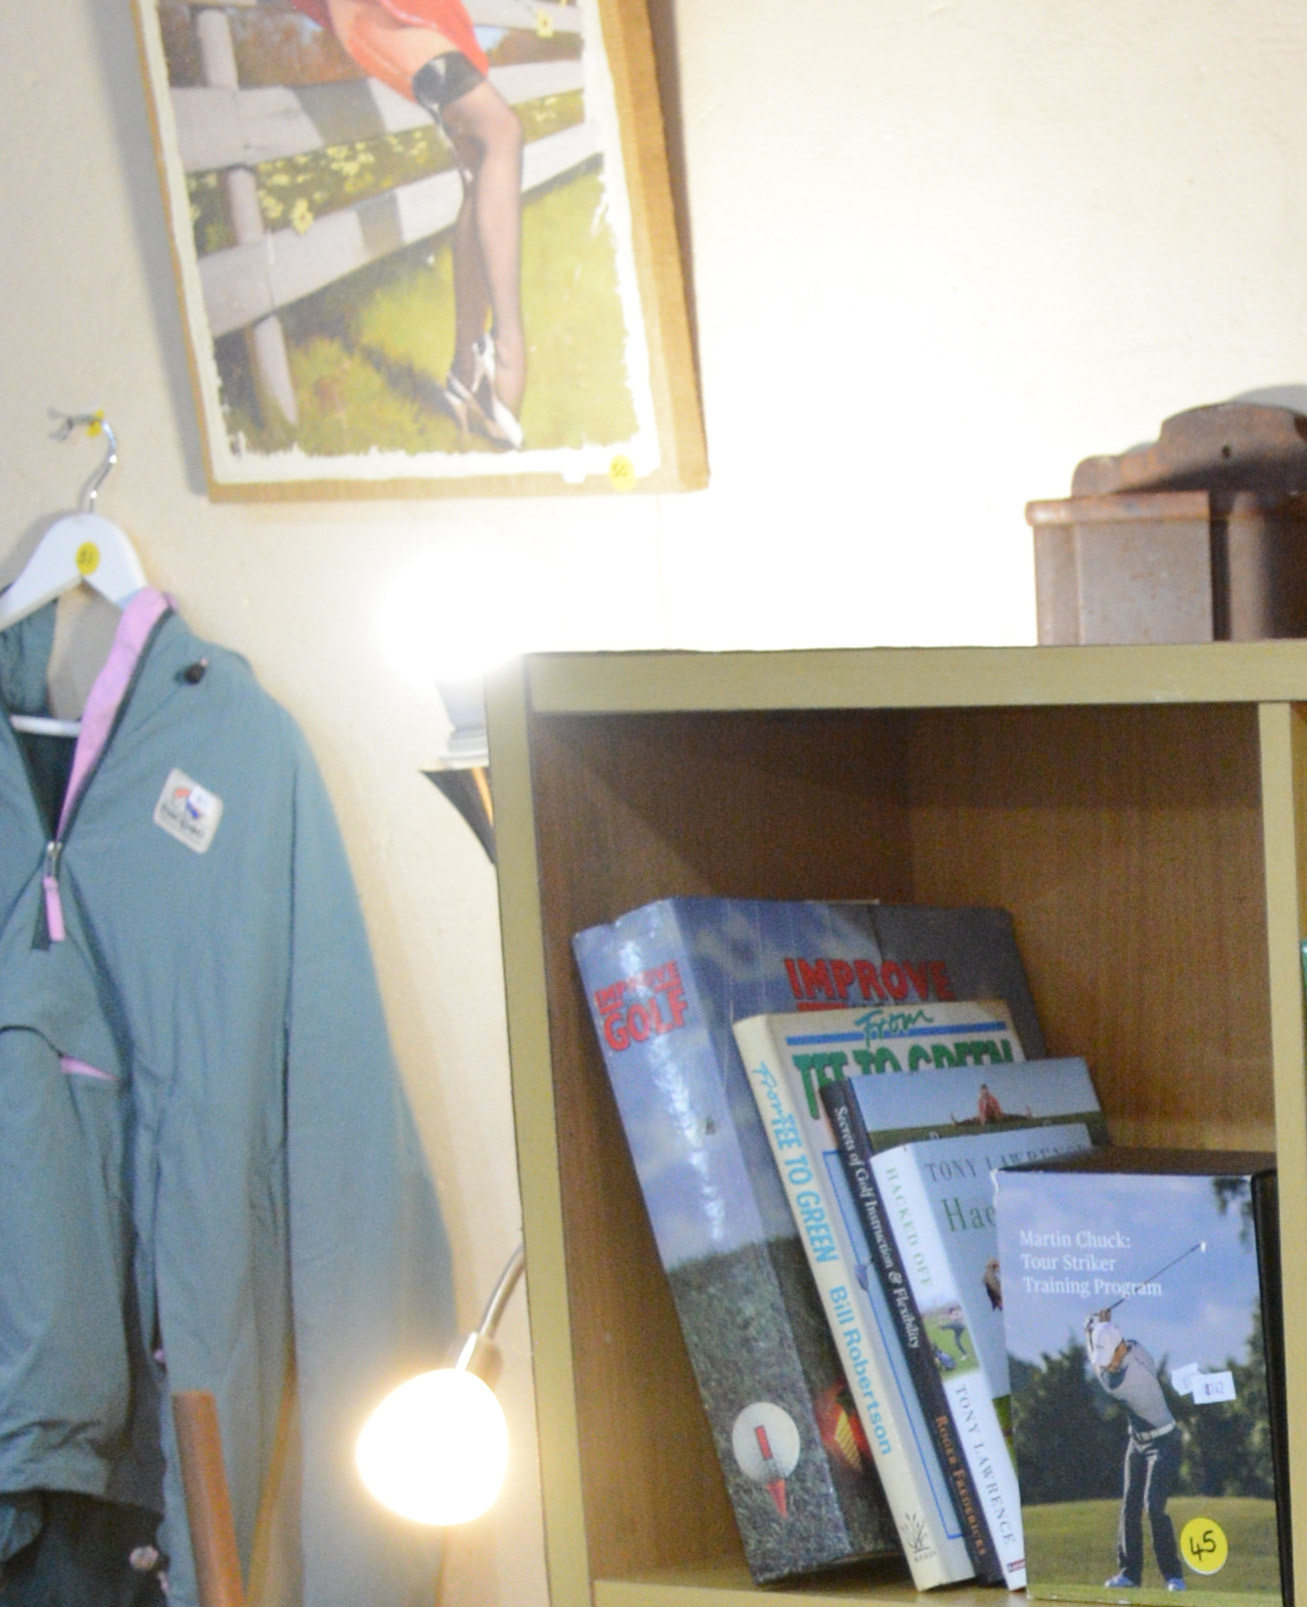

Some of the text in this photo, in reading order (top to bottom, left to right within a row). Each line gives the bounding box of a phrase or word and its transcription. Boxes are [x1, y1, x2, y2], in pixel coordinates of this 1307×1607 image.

[595, 960, 679, 1006] IMPROVE
[784, 957, 955, 1000] IMPROVE
[602, 987, 689, 1051] GOLF
[855, 1008, 933, 1048] From
[752, 1061, 839, 1263] From TEE TO GREEN
[928, 1156, 977, 1183] TONY
[834, 1105, 920, 1349] Secrets of Golf Instruction & Flexibility
[886, 1166, 933, 1287] HACKED OFF
[940, 1197, 997, 1232] Hac
[1019, 1230, 1131, 1250] Martin Chuck:
[1022, 1254, 1116, 1271] Tour Striker
[1023, 1276, 1162, 1298] Training Program
[830, 1285, 892, 1455] Bill Robertson
[956, 1384, 1014, 1545] TONY LAWRENCE
[1190, 1530, 1216, 1561] 45
